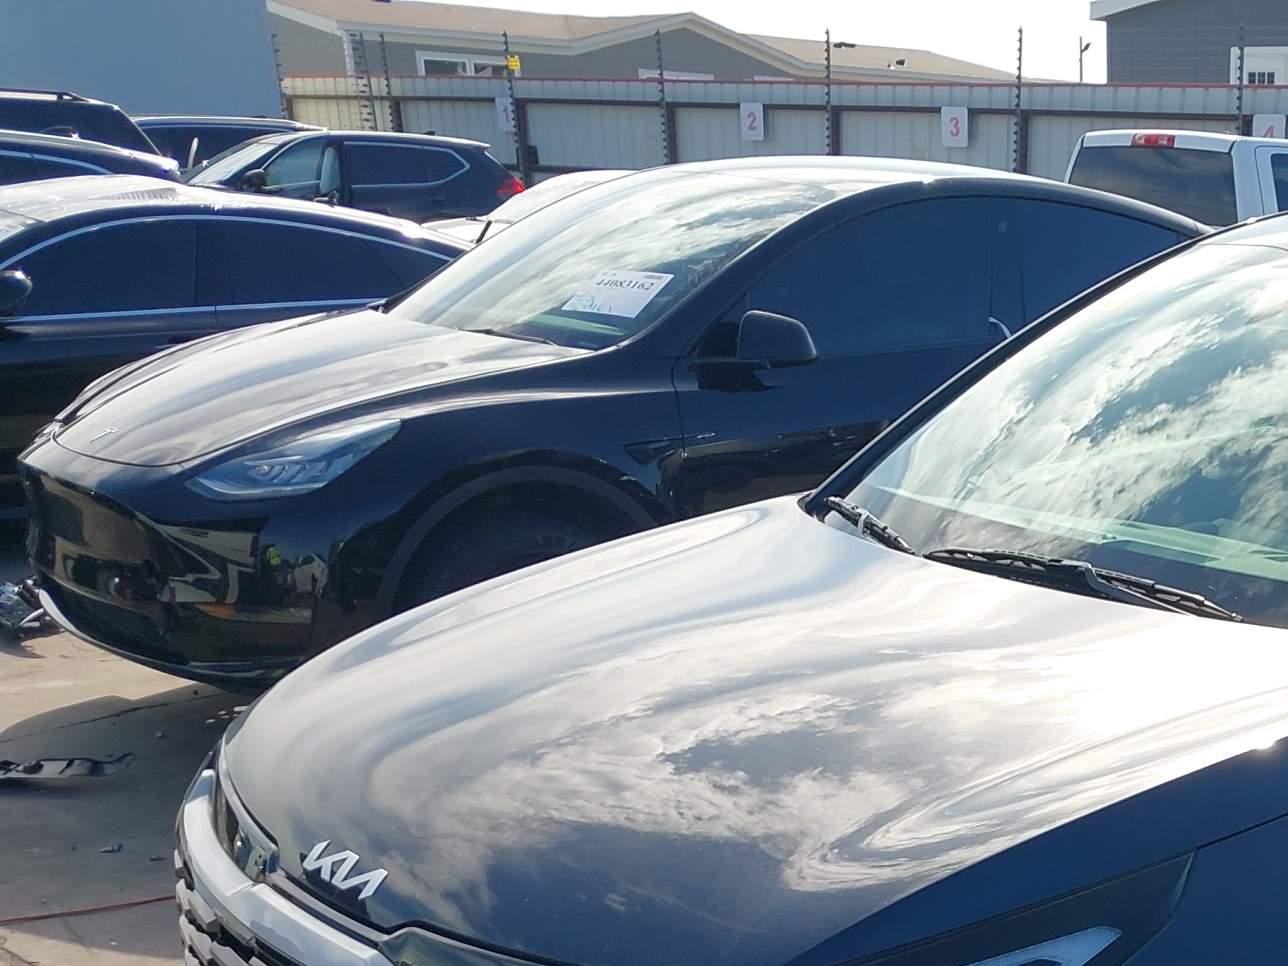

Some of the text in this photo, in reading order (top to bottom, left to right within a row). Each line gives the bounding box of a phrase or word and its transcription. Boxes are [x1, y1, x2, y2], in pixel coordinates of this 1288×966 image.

[747, 111, 757, 130] 2
[950, 116, 960, 137] 3
[596, 279, 656, 291] 44083162
[302, 839, 389, 900] KIA
